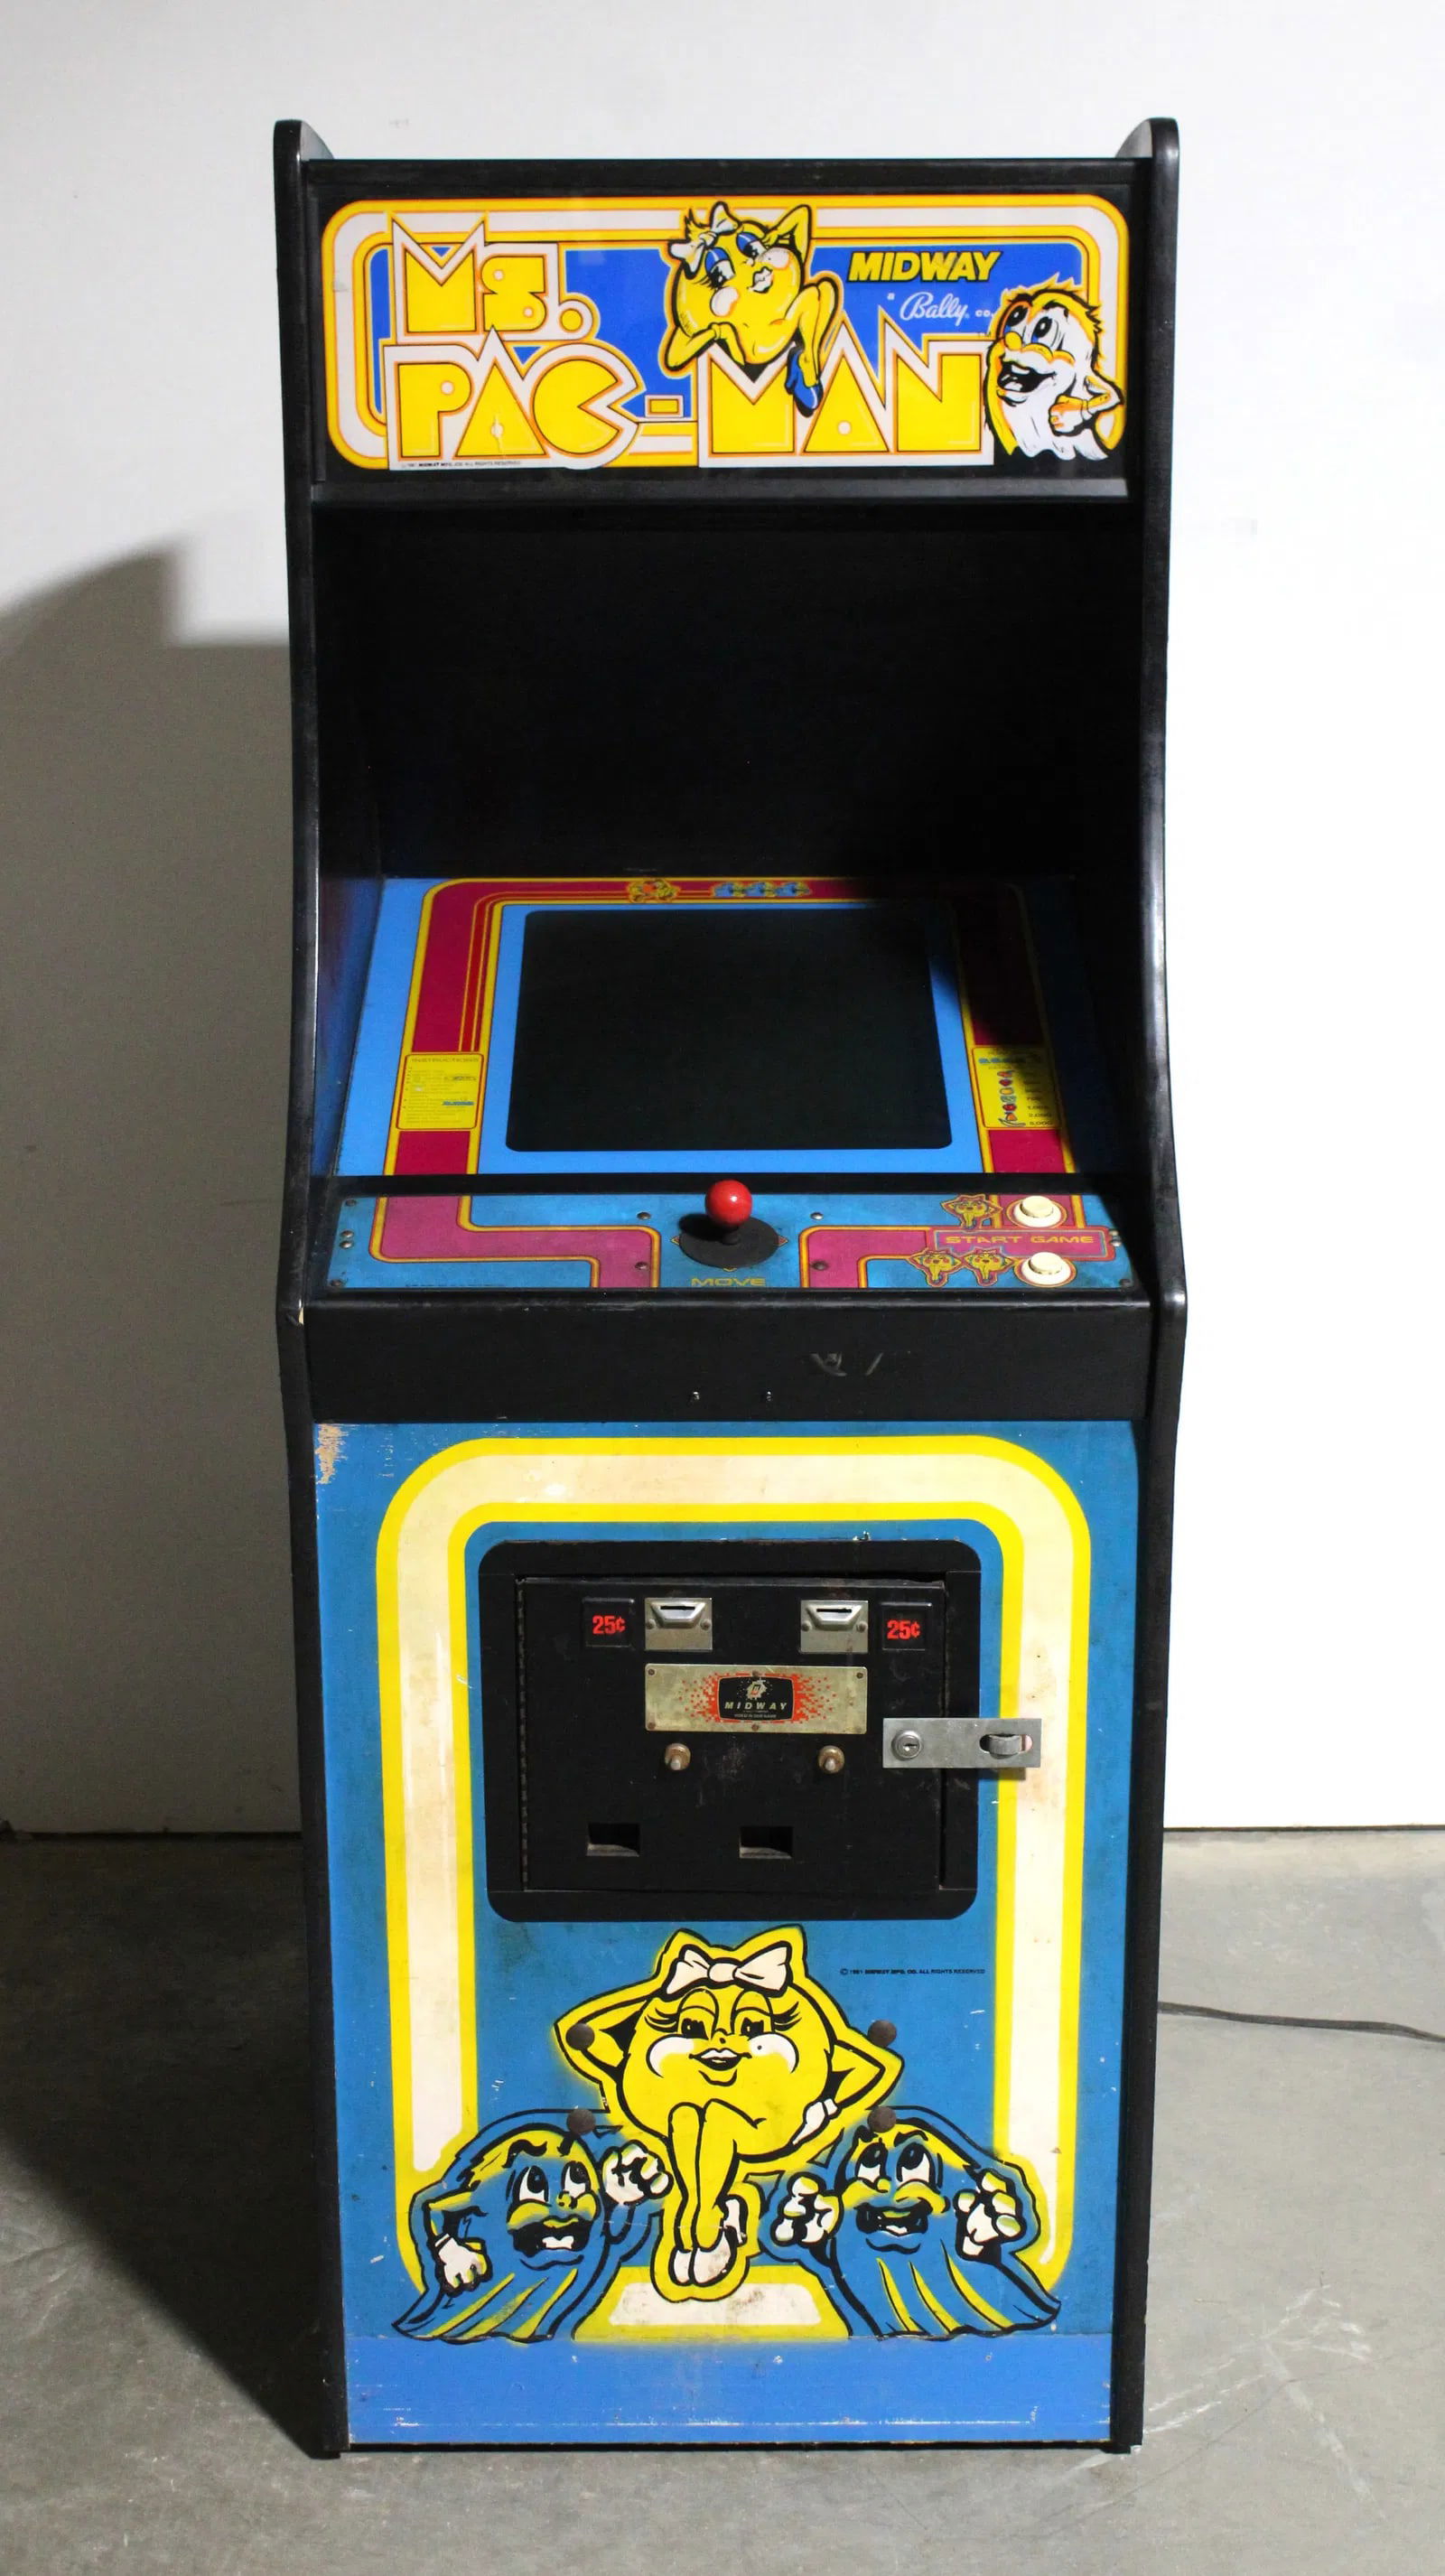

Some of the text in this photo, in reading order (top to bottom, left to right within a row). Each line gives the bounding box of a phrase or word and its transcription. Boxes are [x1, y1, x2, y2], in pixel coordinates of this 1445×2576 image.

[847, 251, 1002, 282] MIDWAY
[388, 330, 989, 462] PAC-MAN
[946, 1235, 1095, 1245] START GAME
[690, 1277, 767, 1287] MOVE
[592, 1614, 627, 1636] 25¢
[886, 1619, 921, 1640] 25¢
[724, 1701, 788, 1711] MIDWAY
